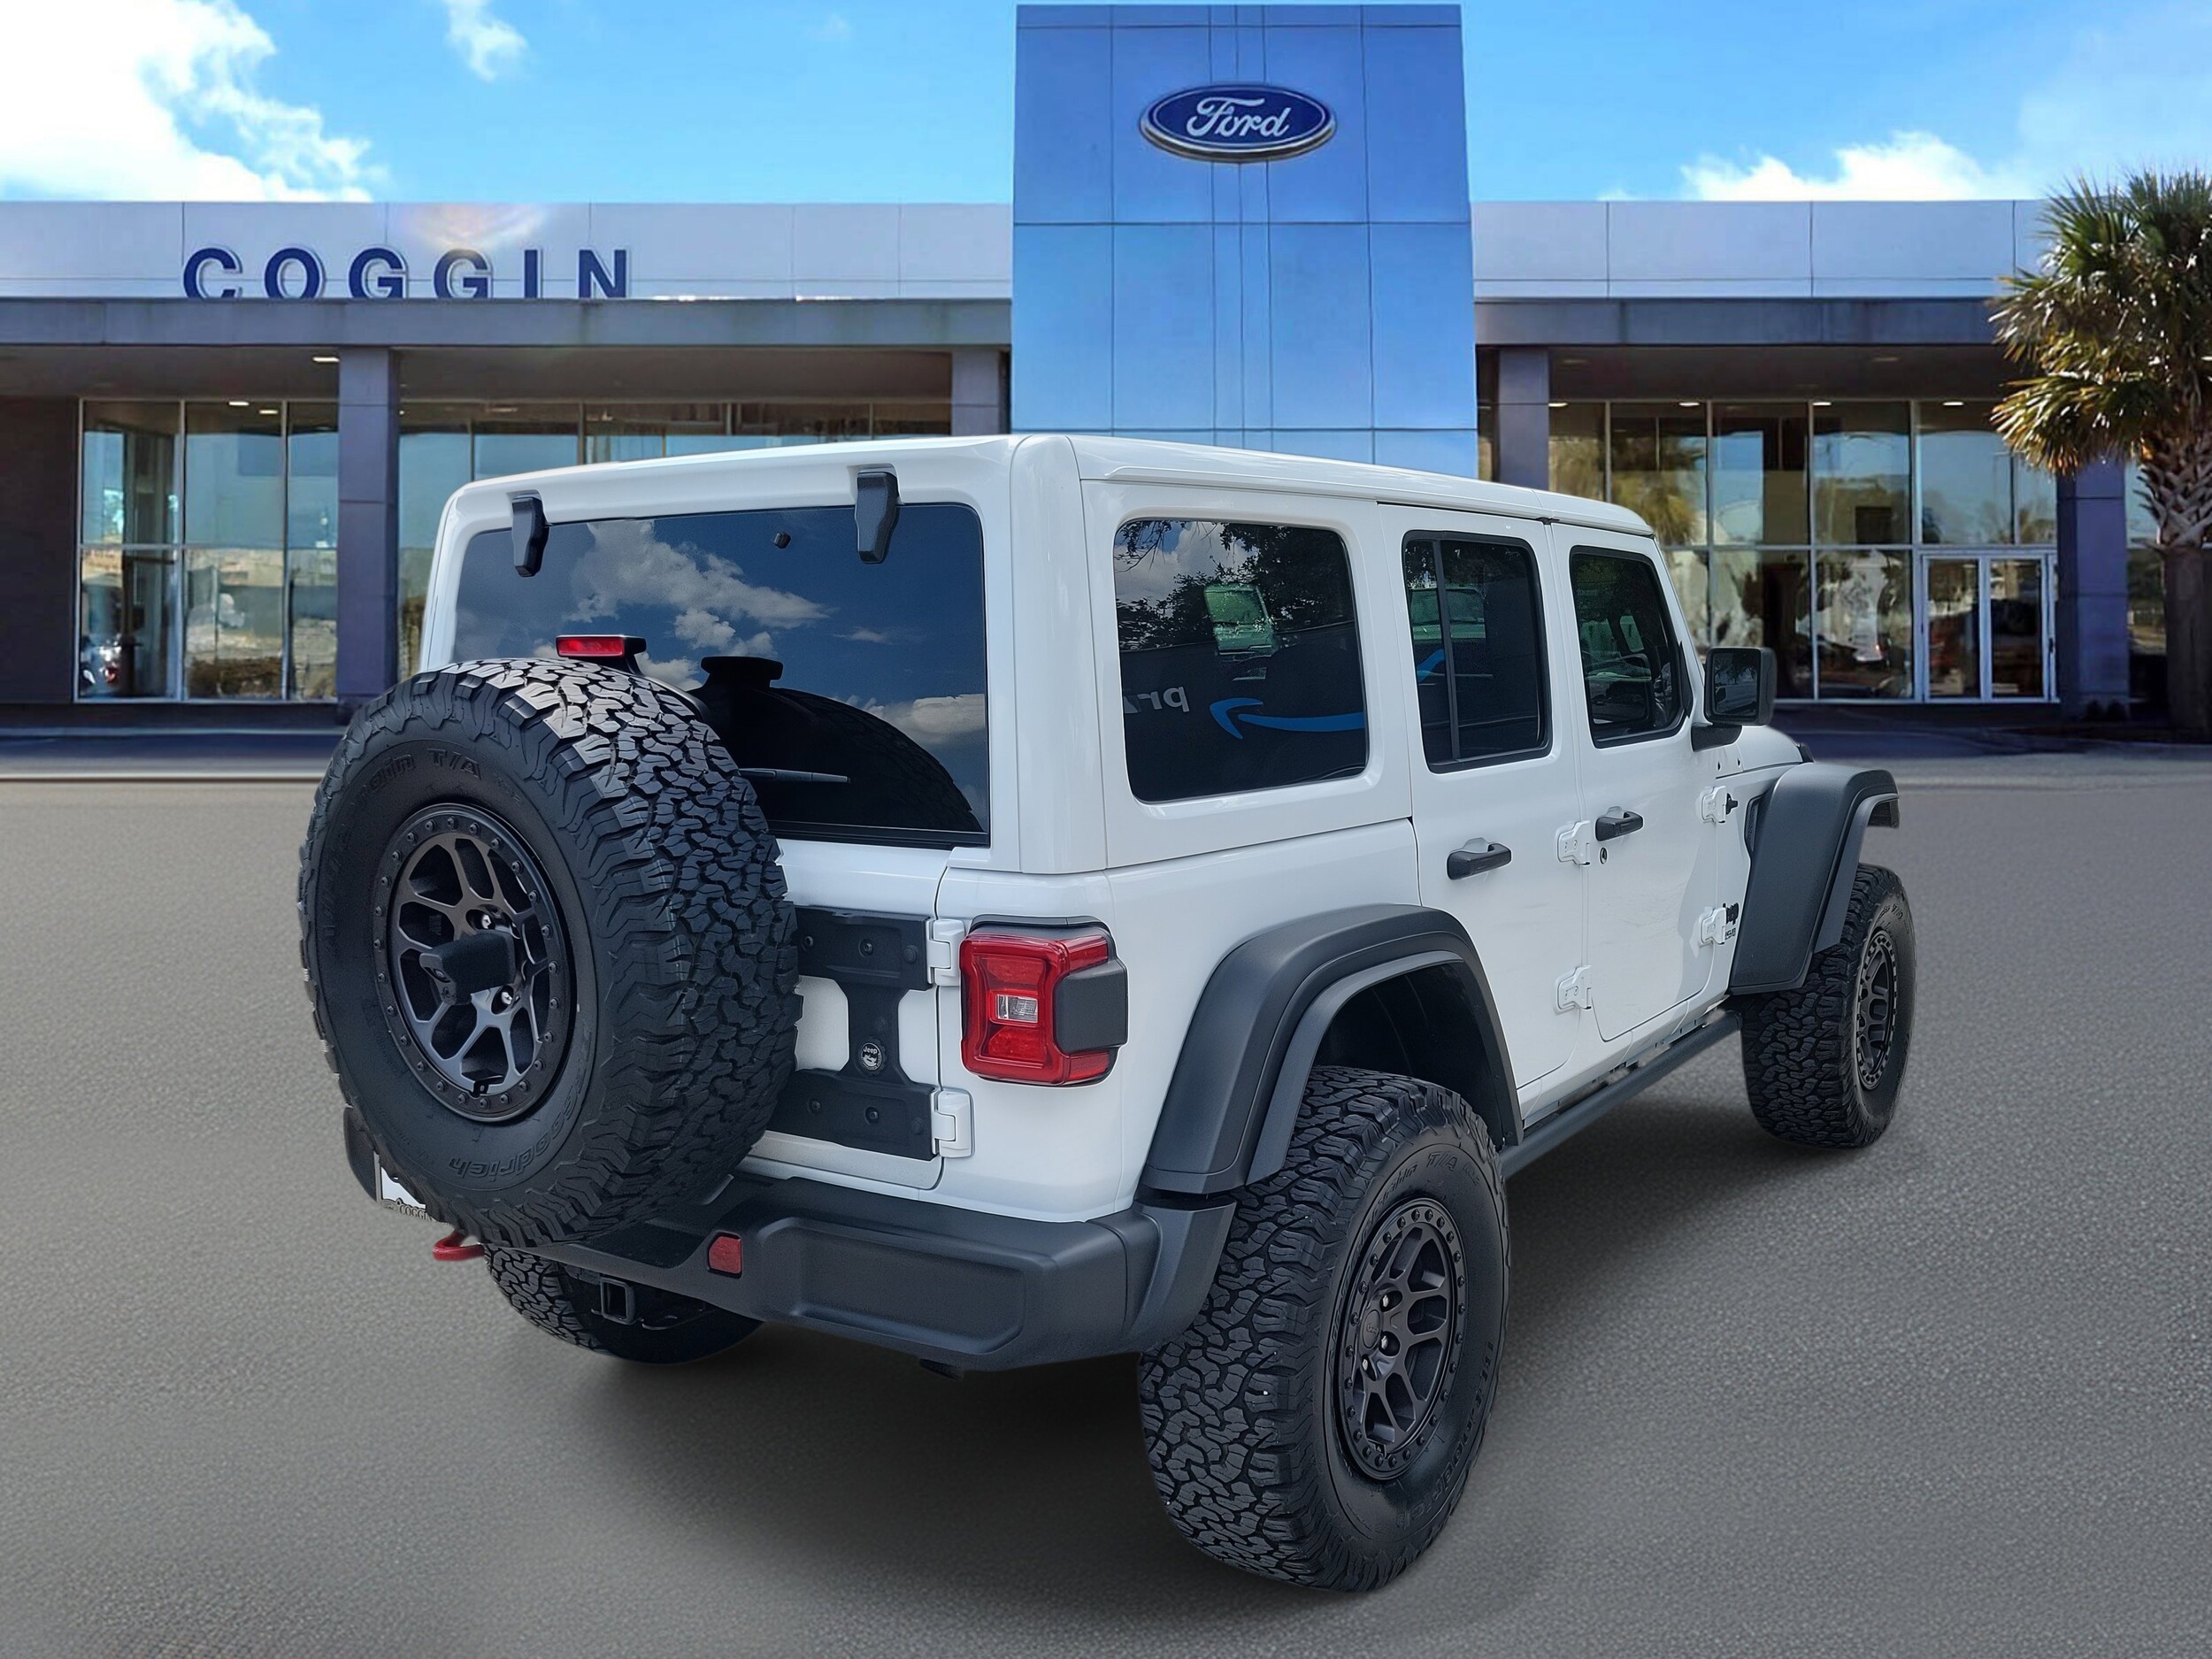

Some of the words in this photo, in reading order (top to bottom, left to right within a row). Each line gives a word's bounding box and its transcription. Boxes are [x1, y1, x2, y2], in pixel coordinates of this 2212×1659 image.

[1186, 96, 1292, 137] Ford
[182, 246, 630, 299] COGGIN
[863, 1046, 878, 1055] Jeep
